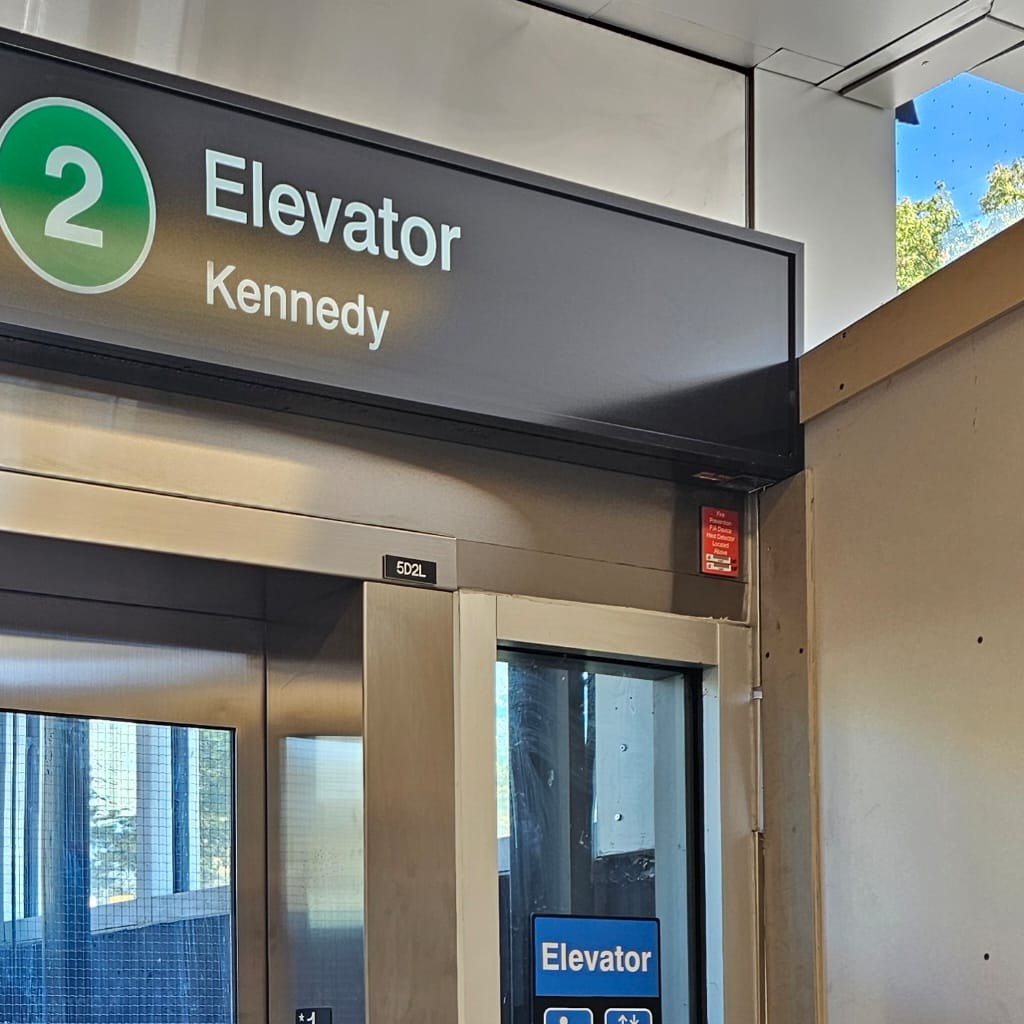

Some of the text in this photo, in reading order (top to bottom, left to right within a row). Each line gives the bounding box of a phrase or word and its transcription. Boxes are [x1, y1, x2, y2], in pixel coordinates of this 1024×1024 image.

[45, 145, 104, 249] 2
[204, 148, 462, 272] Elevator
[205, 260, 390, 352] Kennedy
[396, 561, 426, 578] 5D2L
[541, 942, 652, 972] Elevator
